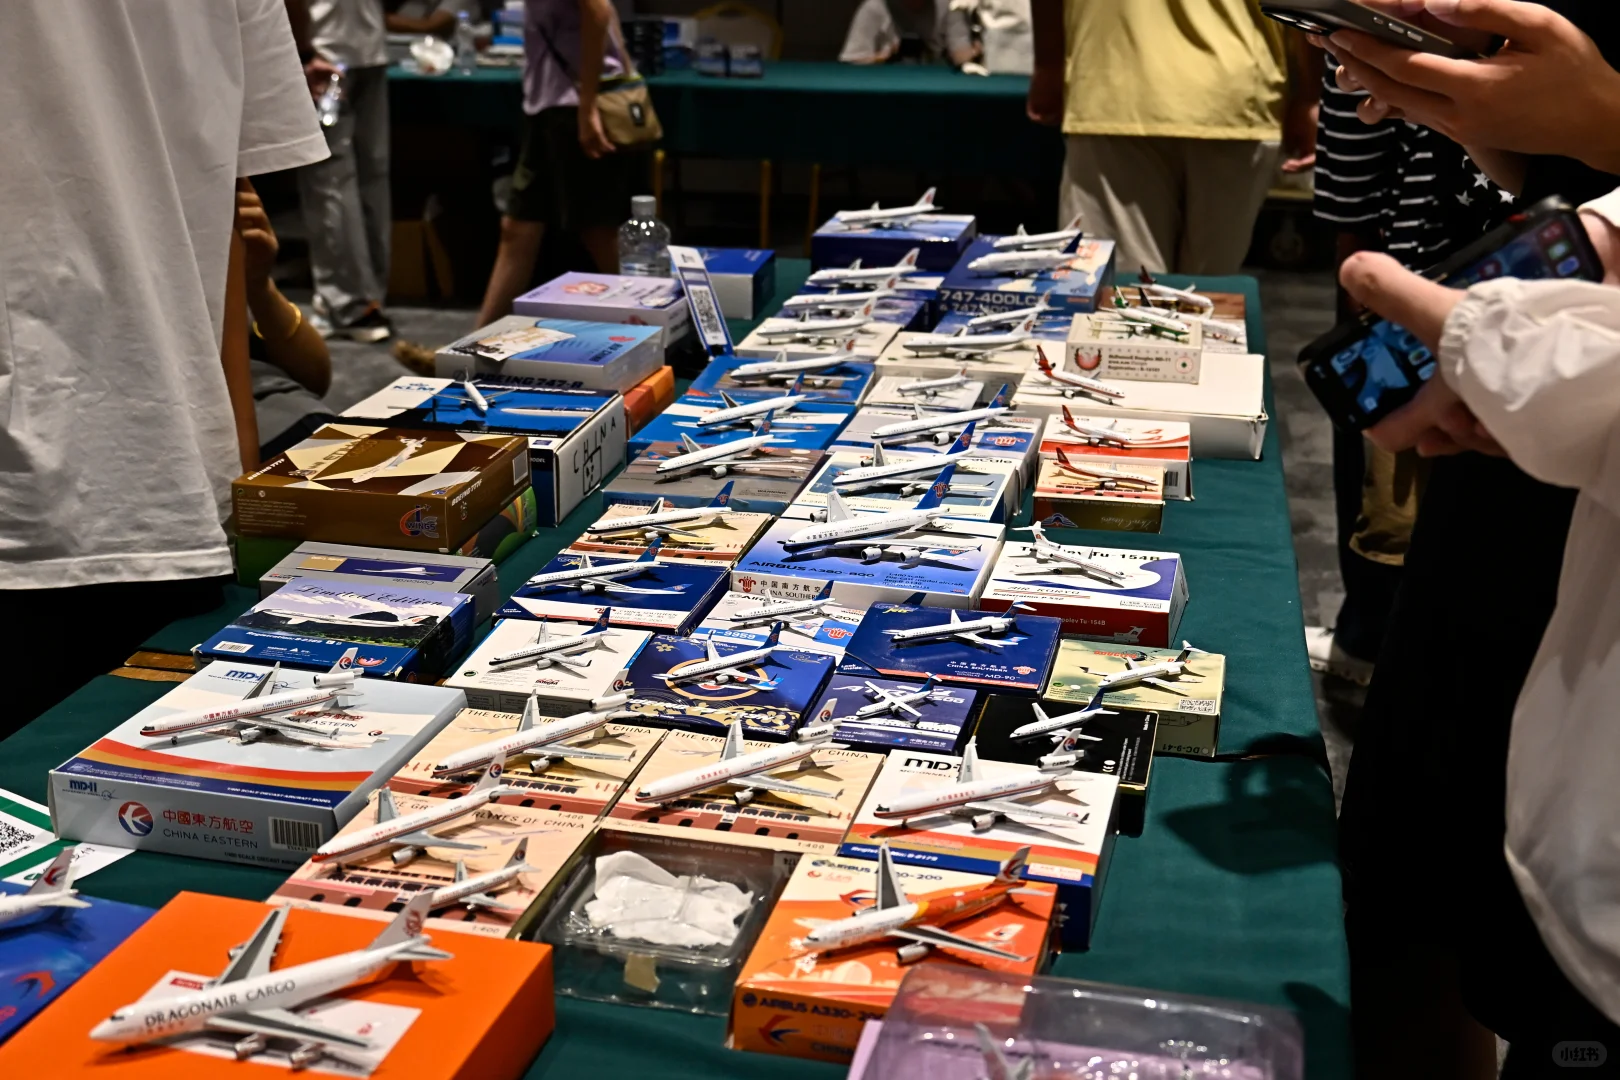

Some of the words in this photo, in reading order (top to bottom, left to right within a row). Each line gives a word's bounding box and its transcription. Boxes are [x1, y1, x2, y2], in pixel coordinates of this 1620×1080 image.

[407, 521, 436, 530] WINGS
[749, 561, 806, 571] AIRBUS
[808, 567, 875, 577] A380-800
[760, 580, 821, 592] 中国南方航空
[760, 588, 782, 597] CINA
[296, 584, 376, 599] Limited
[377, 591, 443, 605] Edition
[741, 595, 792, 605] AIRUS
[225, 670, 265, 681] MD-1
[468, 709, 490, 718] THE
[493, 713, 522, 721] GREA
[613, 725, 652, 734] CHINA
[810, 729, 828, 738] CARGO
[675, 731, 696, 739] THE
[700, 735, 726, 744] GRE
[828, 749, 869, 759] CHINA
[1162, 743, 1200, 754] DC-9-41
[69, 779, 98, 793] MD-11
[162, 809, 255, 834] 中國東方航空
[523, 818, 538, 826] OF
[543, 820, 585, 828] CHINA
[163, 828, 200, 840] CHINA
[203, 834, 258, 849] EASTERN
[798, 842, 825, 850] 1:400
[144, 994, 239, 1027] DRAGONAIR
[246, 979, 296, 1001] CARGO
[760, 997, 808, 1012] AIRBUS
